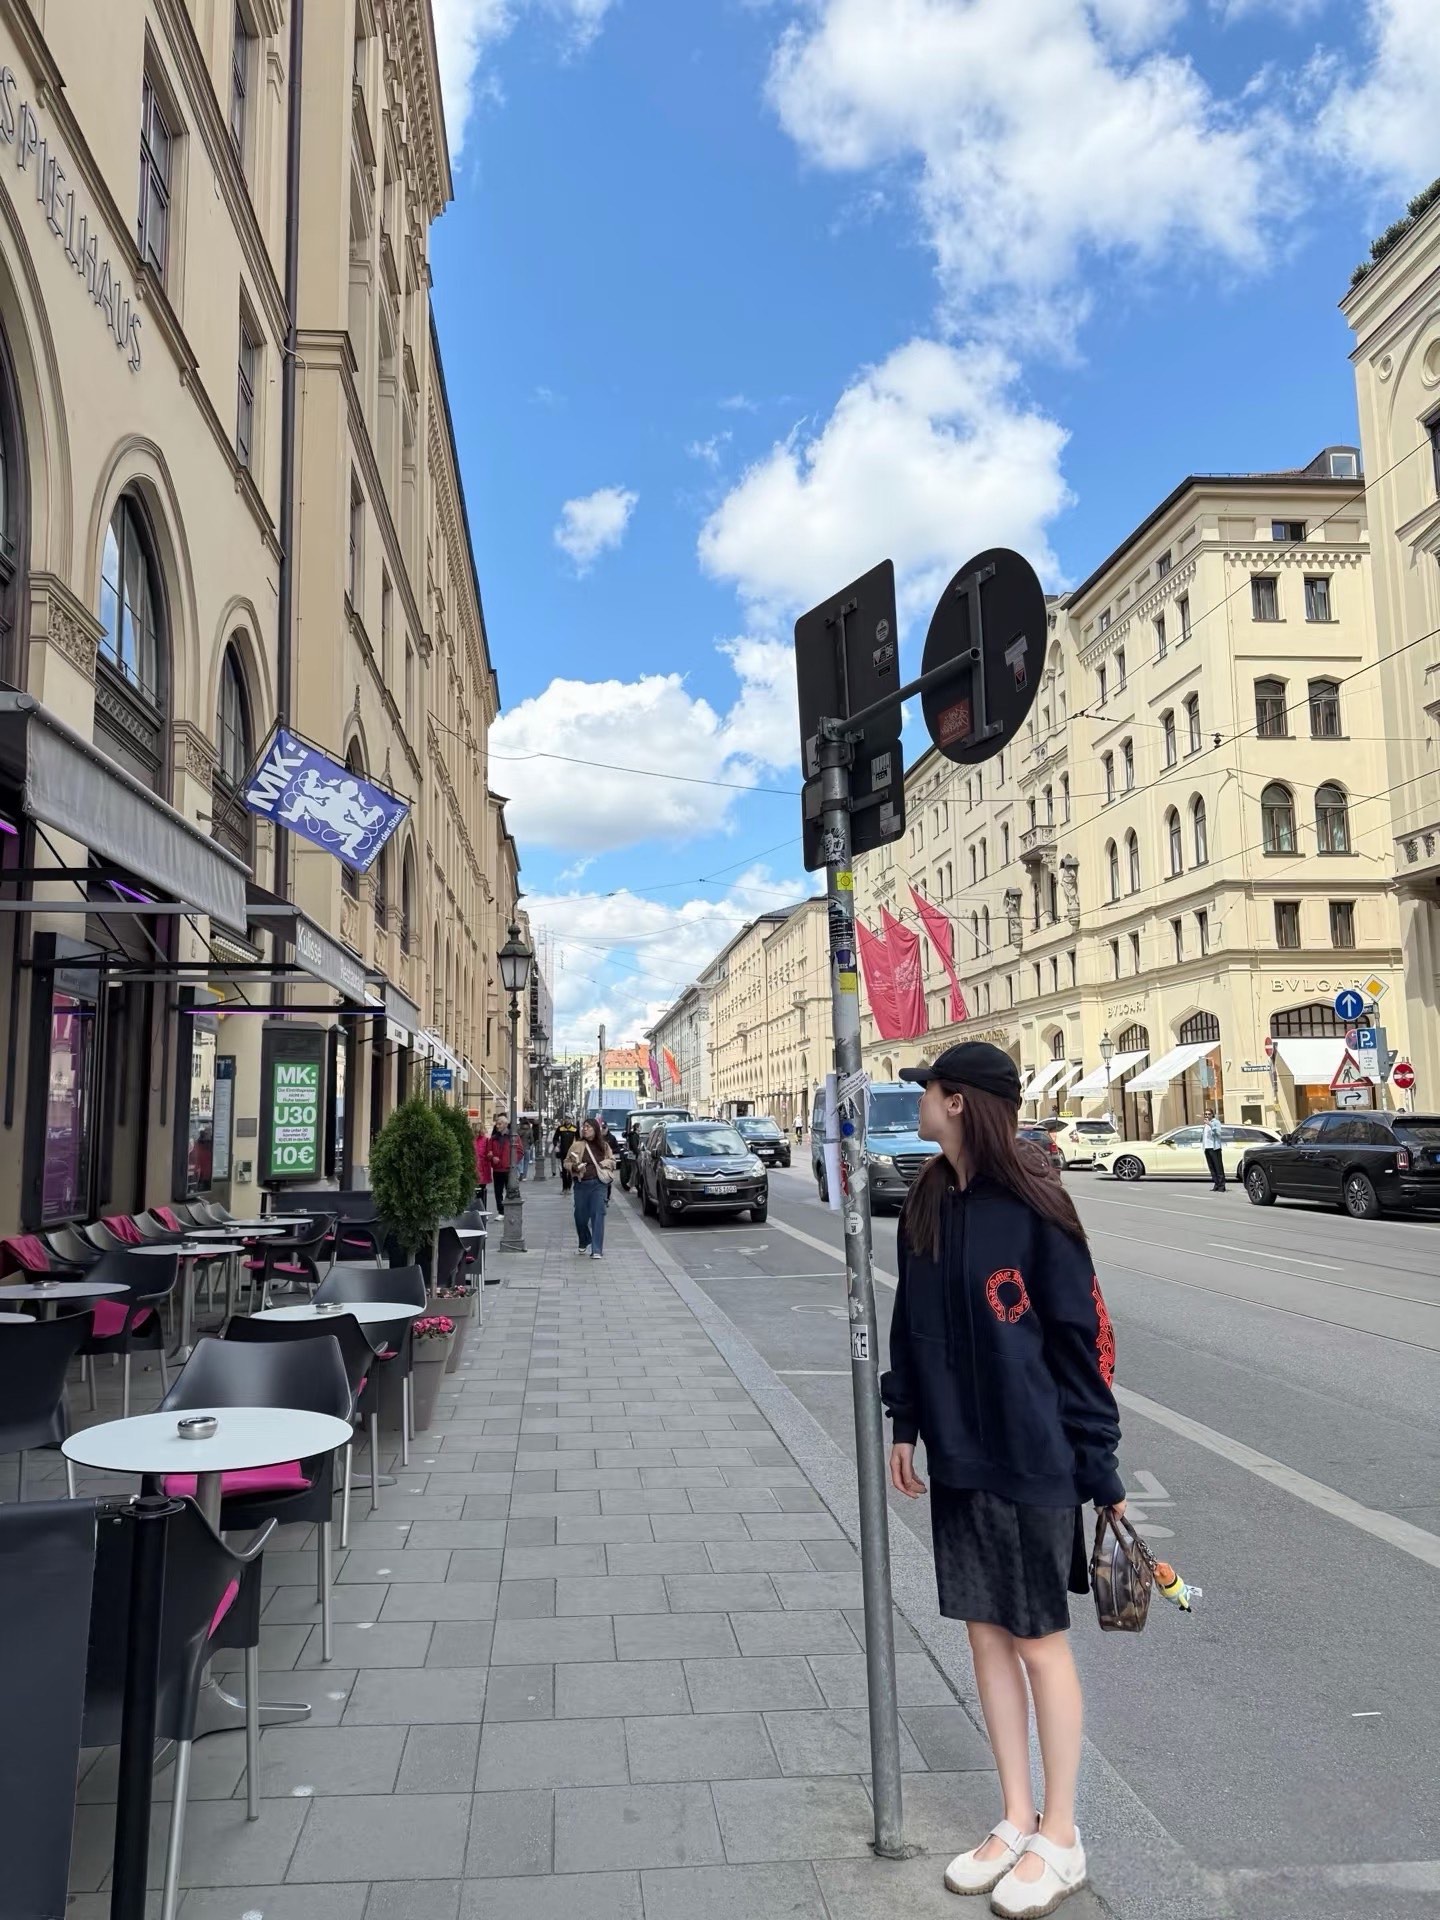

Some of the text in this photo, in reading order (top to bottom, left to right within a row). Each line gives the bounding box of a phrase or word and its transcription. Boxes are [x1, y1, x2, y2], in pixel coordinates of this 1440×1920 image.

[247, 741, 308, 812] MK:
[362, 808, 405, 867] Theater der Stadt
[297, 924, 322, 966] Kulisse
[1271, 978, 1363, 993] BVLGAR
[1107, 1001, 1146, 1018] BVLGARI
[1359, 1031, 1371, 1048] P
[277, 1066, 316, 1084] MK:
[274, 1106, 317, 1124] U30
[274, 1146, 314, 1164] 10€
